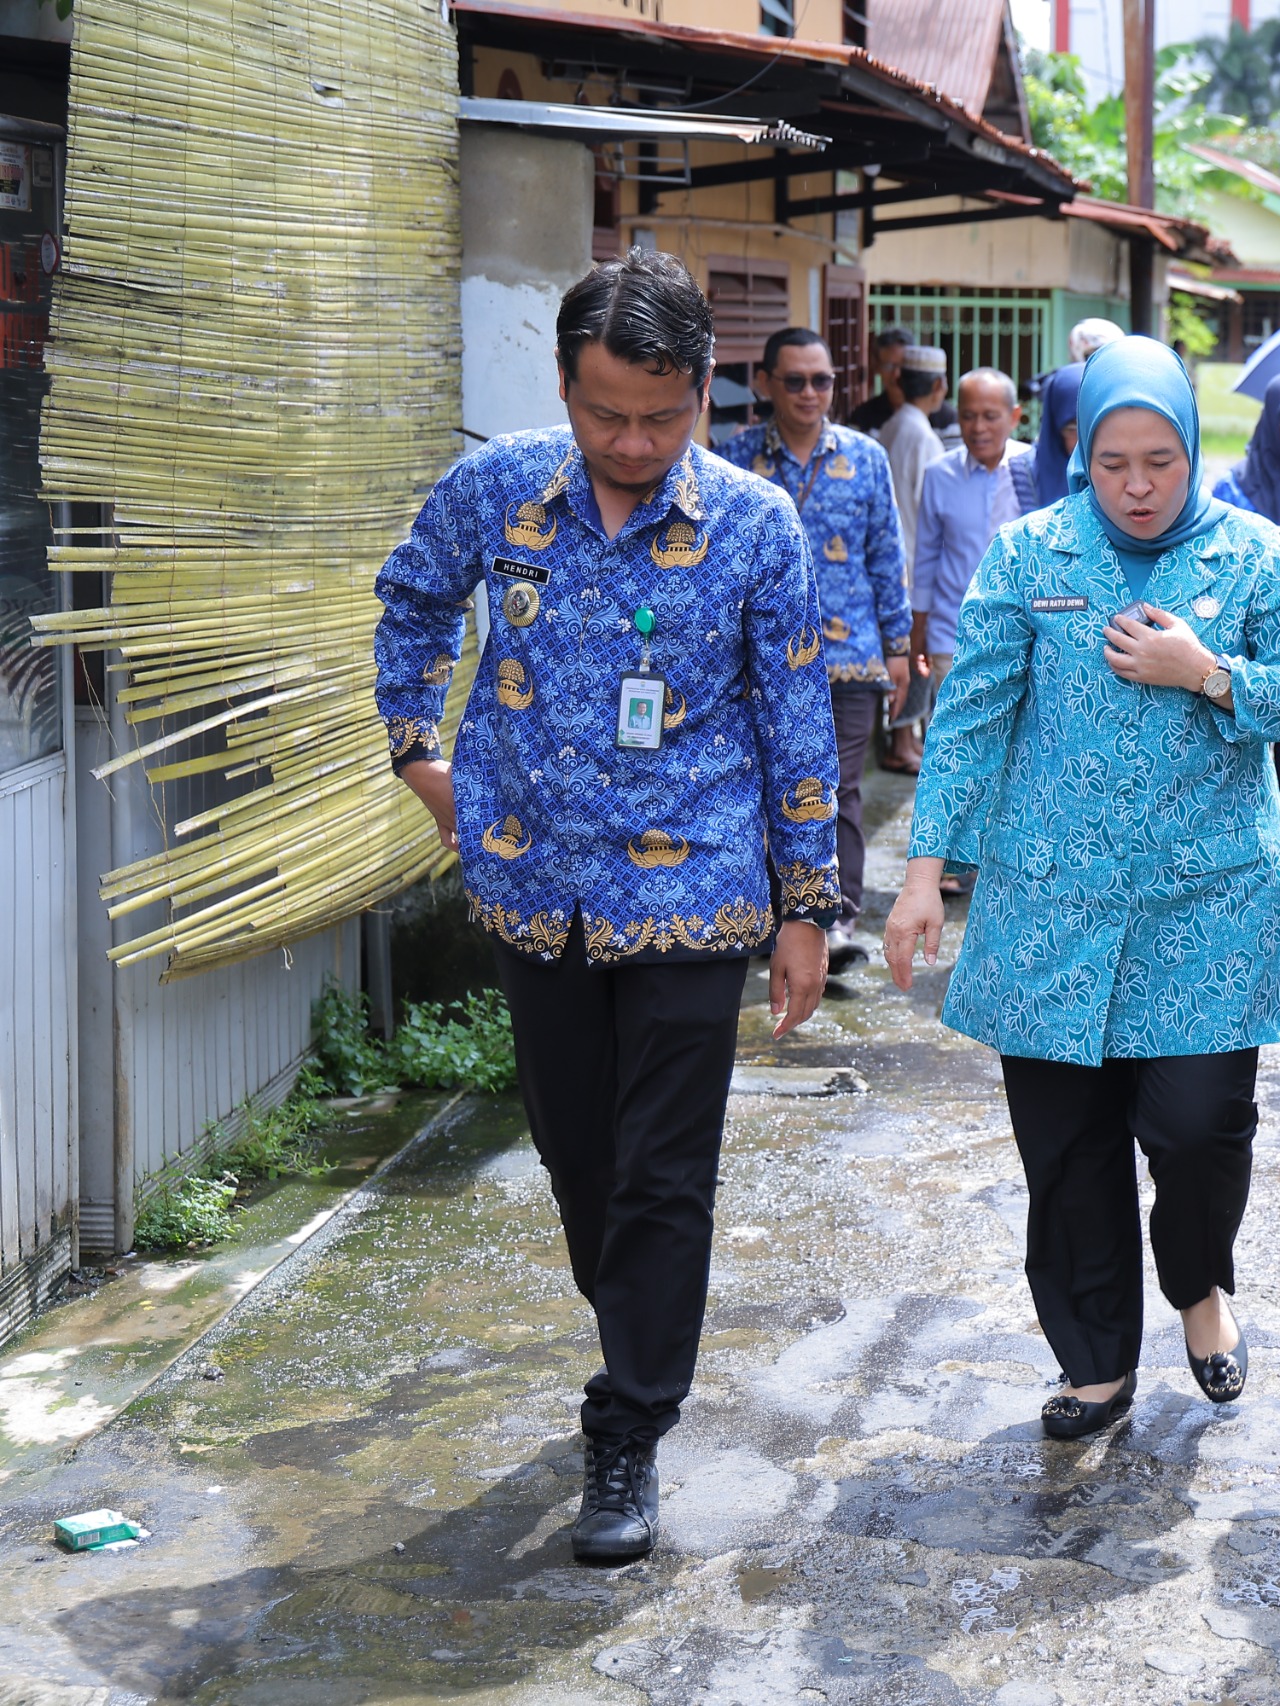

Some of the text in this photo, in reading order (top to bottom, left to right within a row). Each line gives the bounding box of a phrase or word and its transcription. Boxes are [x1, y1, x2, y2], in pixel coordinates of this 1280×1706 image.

[503, 563, 539, 578] HENDRI
[1033, 598, 1084, 608] DEWI RATU DEWA
